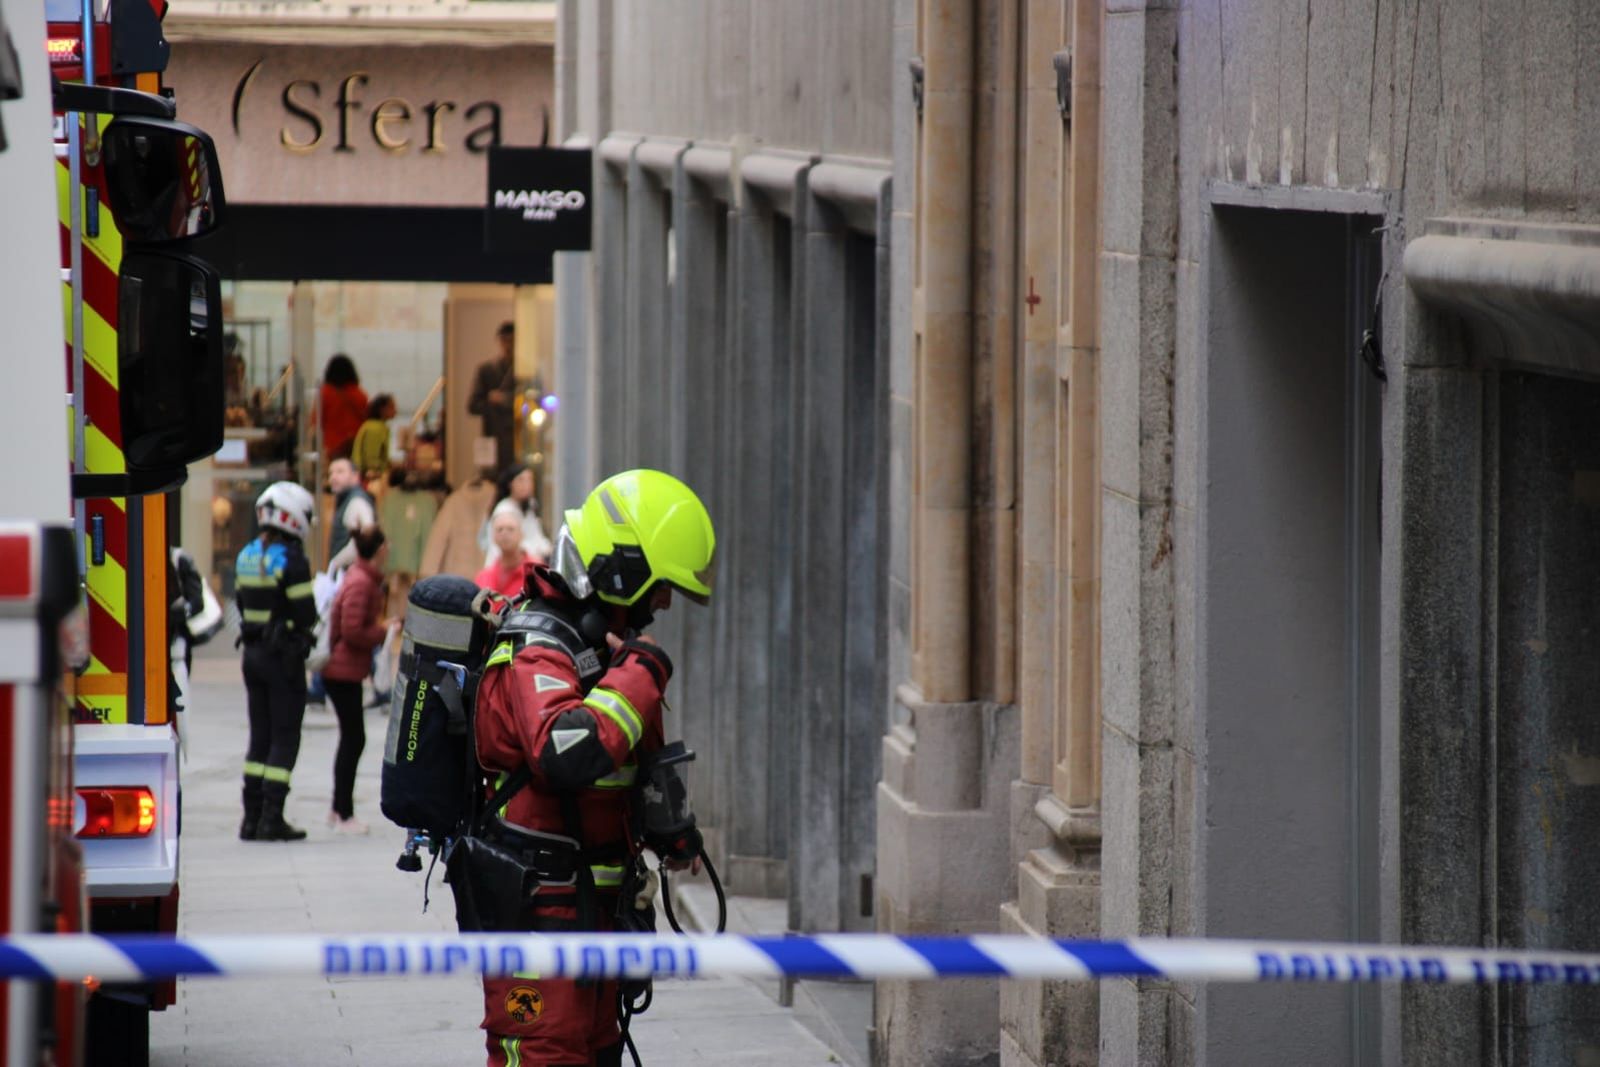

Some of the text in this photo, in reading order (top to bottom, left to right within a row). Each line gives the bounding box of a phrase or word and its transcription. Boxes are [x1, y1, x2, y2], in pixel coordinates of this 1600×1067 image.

[280, 73, 500, 154] Sfera
[494, 189, 585, 209] MANGO
[406, 679, 428, 761] BOMBEROS
